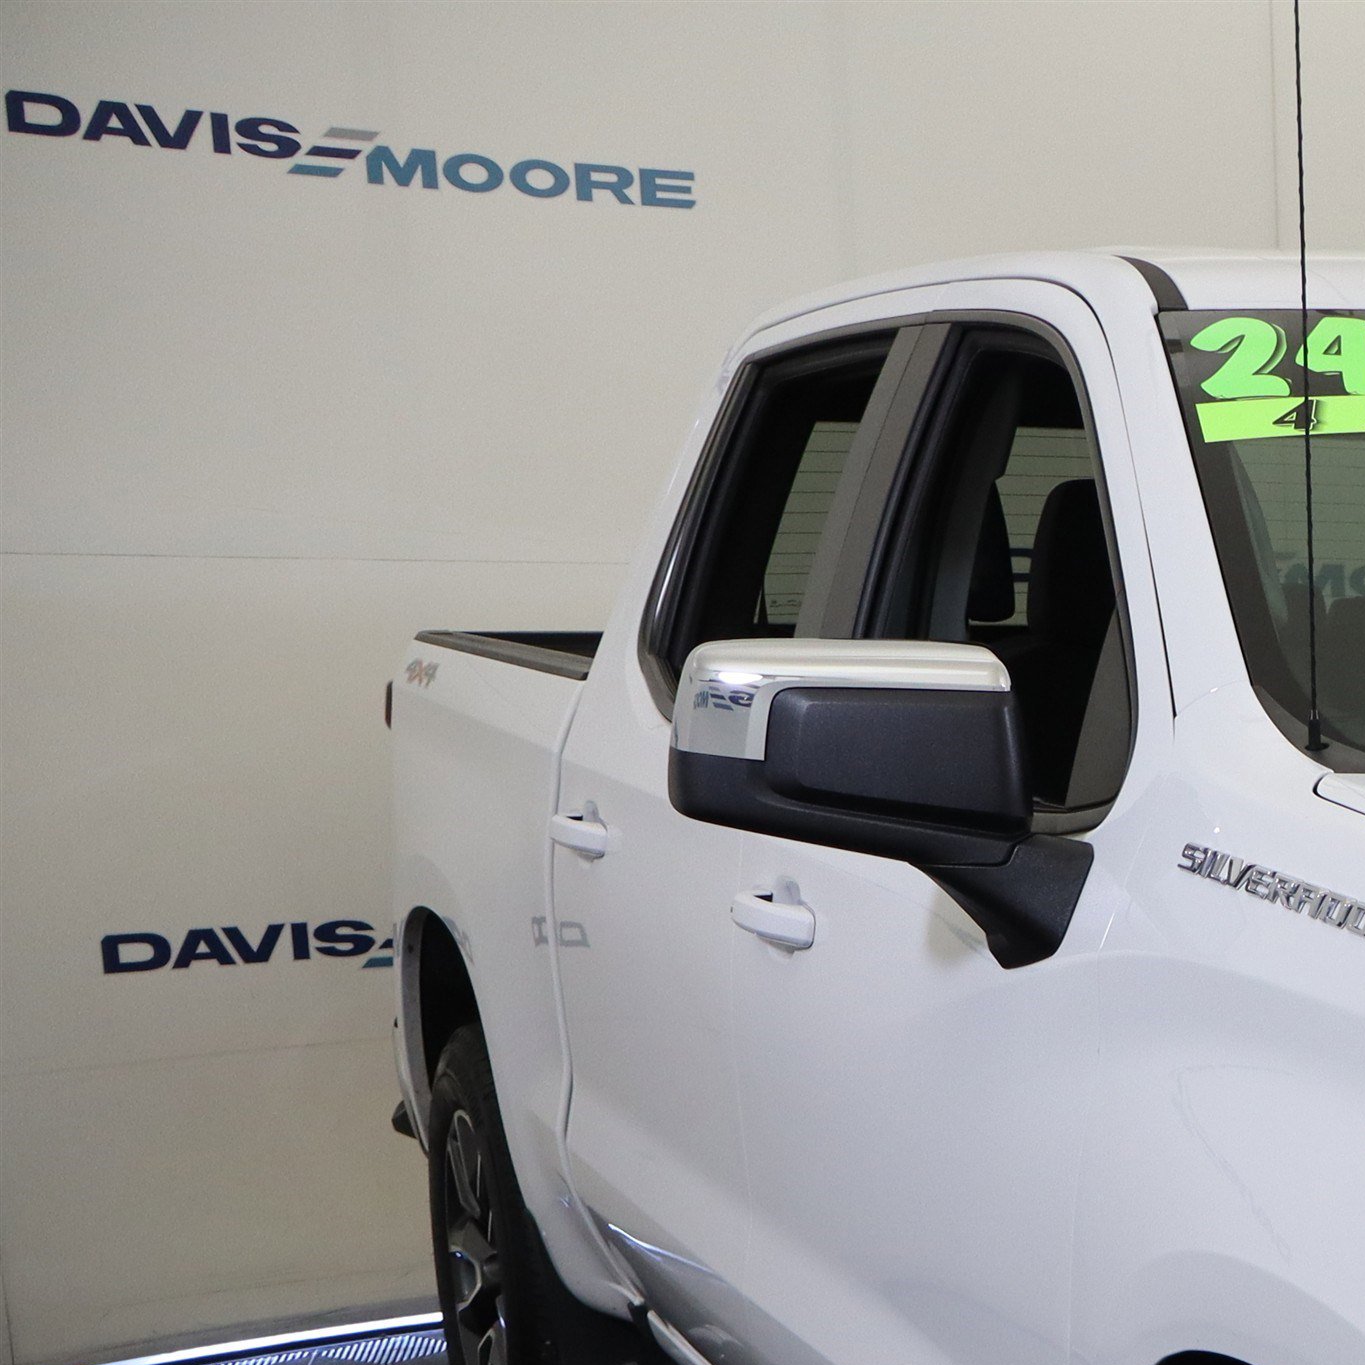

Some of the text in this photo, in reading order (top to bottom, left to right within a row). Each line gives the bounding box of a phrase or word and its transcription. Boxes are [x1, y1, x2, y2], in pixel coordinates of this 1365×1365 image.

[4, 89, 697, 210] DAVIS MOORE
[101, 920, 376, 974] DAVIS
